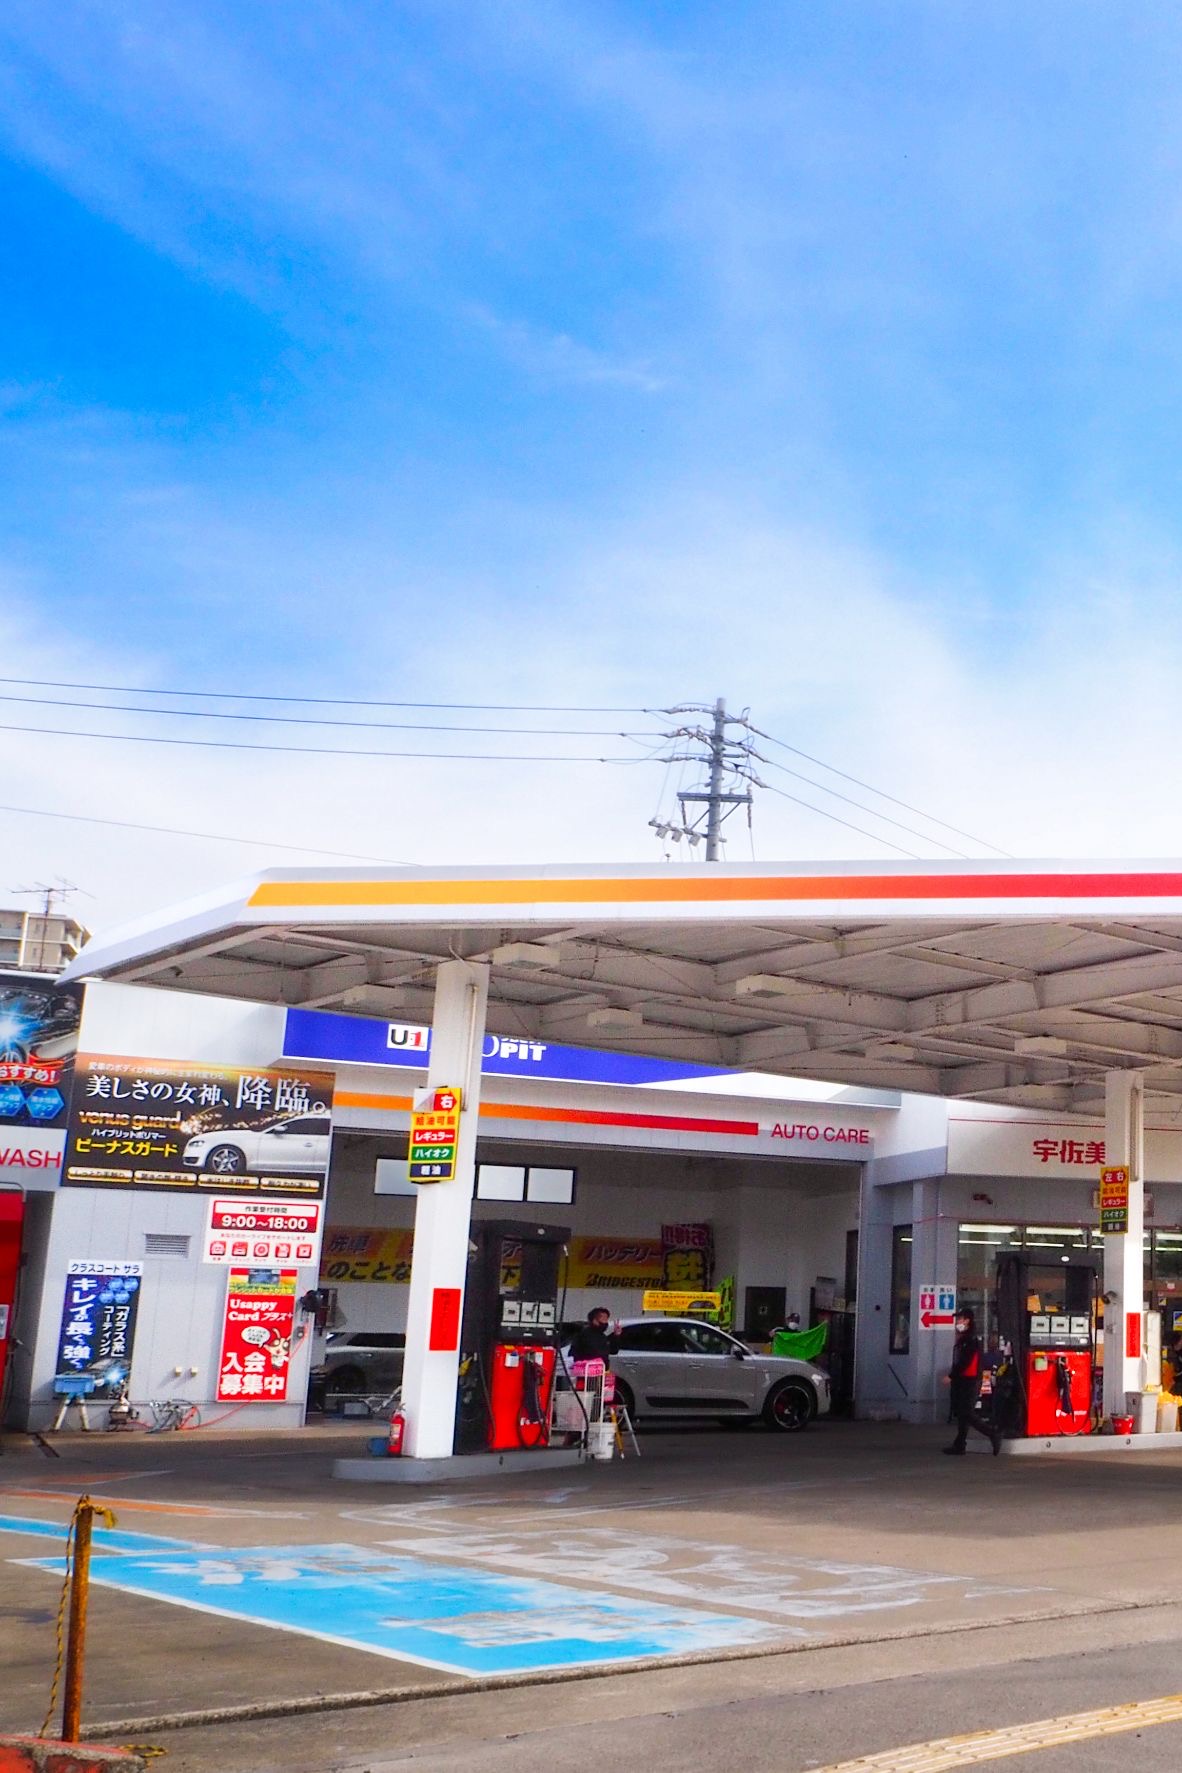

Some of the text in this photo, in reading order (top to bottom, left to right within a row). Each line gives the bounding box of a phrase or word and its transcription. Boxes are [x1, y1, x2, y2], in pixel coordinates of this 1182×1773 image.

[500, 1043, 546, 1061] PIT
[86, 1074, 327, 1113] 美しさの女神、降臨。
[440, 1095, 453, 1109] 右
[415, 1131, 453, 1141] レギュラー
[771, 1123, 869, 1144] AUTO CARE
[75, 1138, 178, 1158] ビーナスガード
[415, 1149, 450, 1158] ハイオク
[1033, 1139, 1105, 1165] 宇佐美
[245, 1206, 288, 1214] 作業受付時間
[584, 1272, 665, 1289] BRIDGESTO
[230, 1299, 278, 1311] Usappy
[228, 1311, 259, 1321] Card
[100, 1306, 115, 1356] コーティング
[222, 1352, 266, 1373] 入会
[220, 1373, 285, 1395] 募集中
